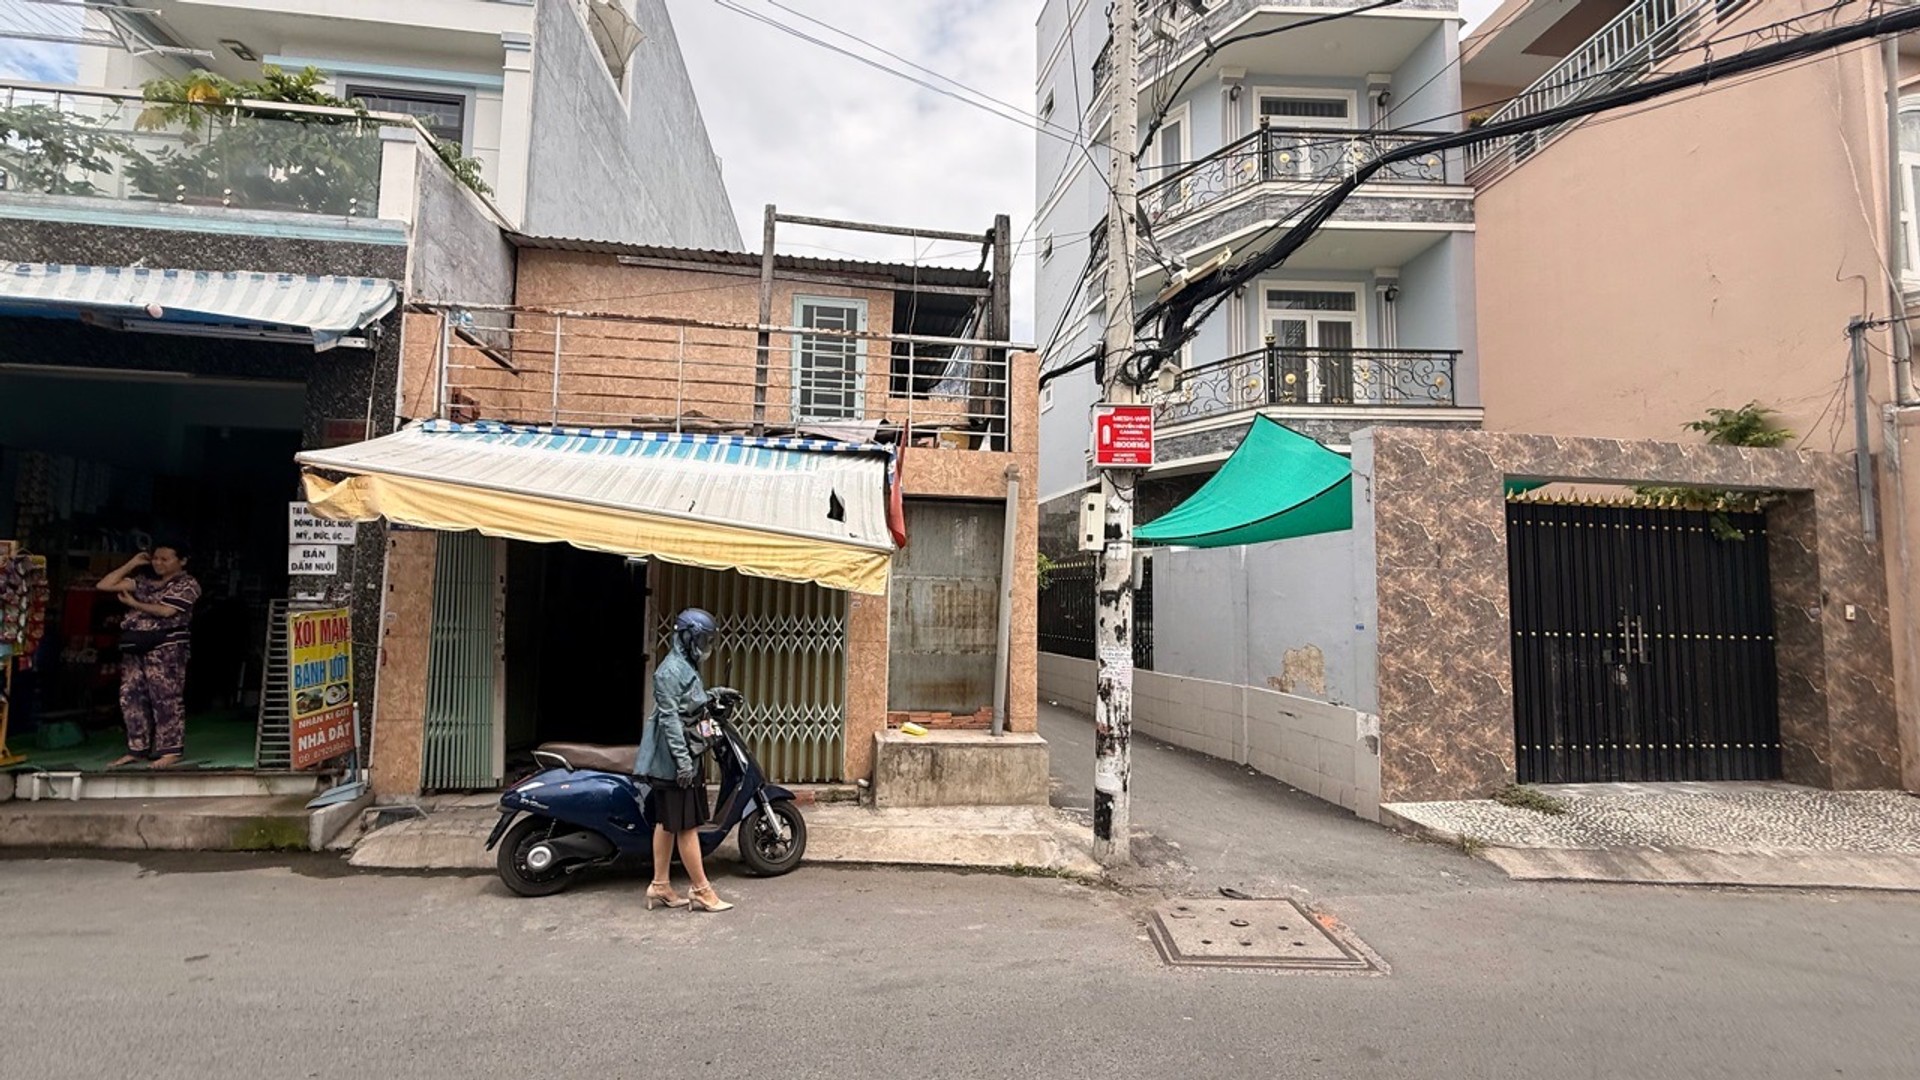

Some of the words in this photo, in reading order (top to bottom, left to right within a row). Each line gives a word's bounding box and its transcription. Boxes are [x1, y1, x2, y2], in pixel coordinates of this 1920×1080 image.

[303, 548, 326, 558] BÁN
[294, 615, 316, 649] XÔI
[320, 613, 349, 649] MẶN
[294, 657, 326, 690] BÁNH
[298, 727, 326, 752] NHÀ
[328, 719, 351, 741] ĐẤT
